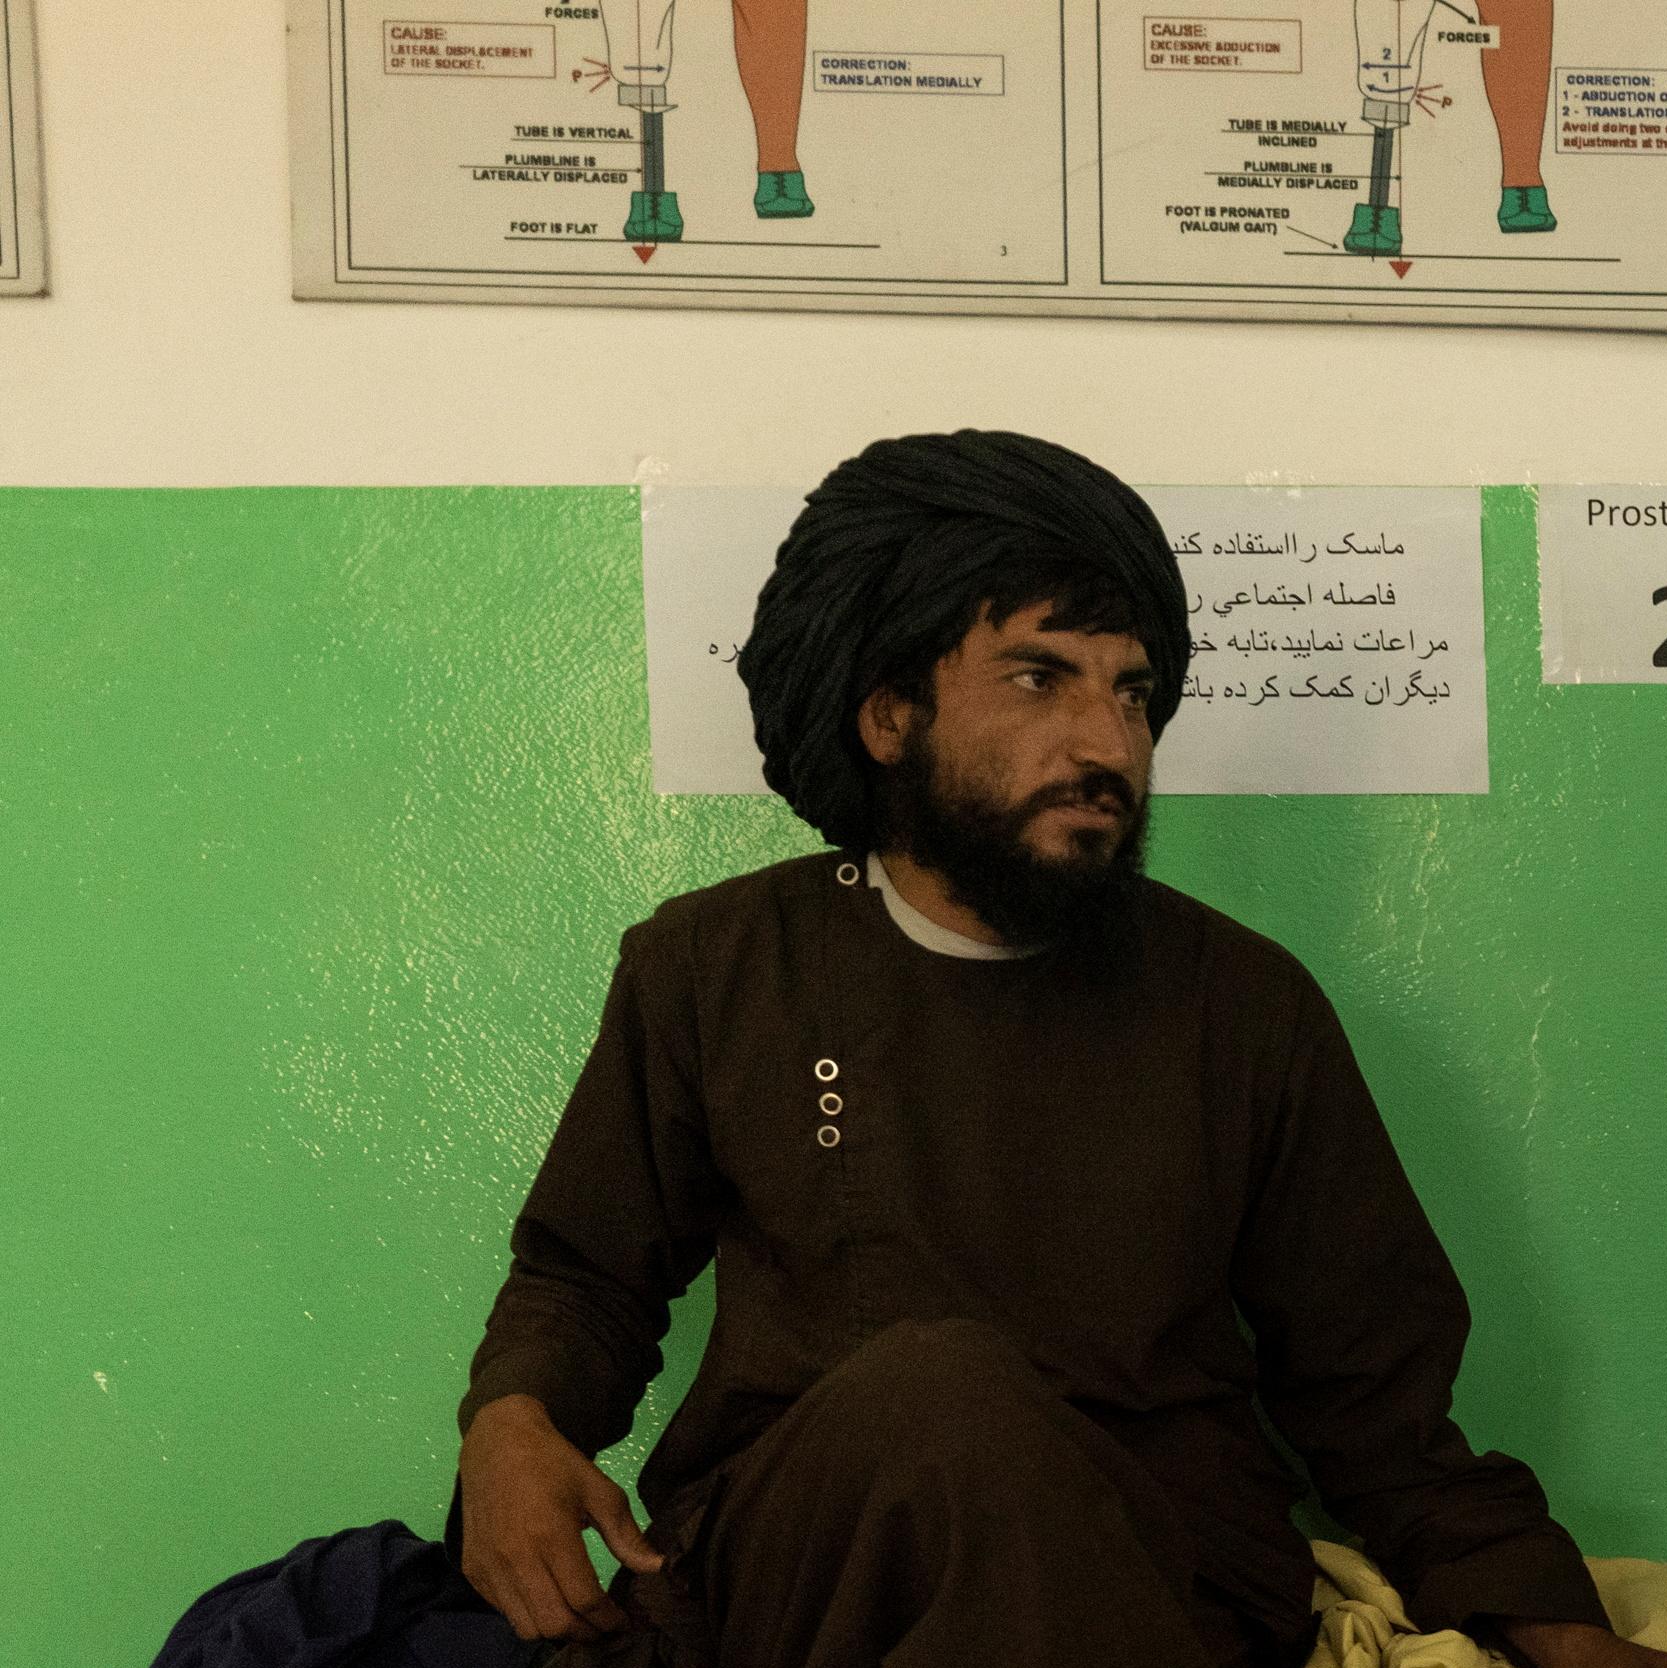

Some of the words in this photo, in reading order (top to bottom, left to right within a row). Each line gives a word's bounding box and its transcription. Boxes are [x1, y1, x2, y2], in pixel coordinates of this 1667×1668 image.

[545, 7, 599, 19] FORCES
[391, 27, 447, 40] CAUSE:
[1151, 23, 1207, 37] CAUSE:
[1438, 31, 1490, 43] FORCES
[391, 44, 440, 56] LATERAL
[446, 46, 533, 58] DISPLACEMENT
[1151, 40, 1212, 52] EXCESSIVE
[1151, 54, 1164, 64] OF
[1170, 54, 1190, 65] THE
[1194, 55, 1242, 66] SOCKET.
[1382, 48, 1391, 60] 2
[391, 58, 405, 68] OF
[411, 58, 432, 69] THE
[435, 59, 485, 70] SOCKET.
[821, 58, 911, 71] CORRECTION:
[572, 70, 582, 82] P
[821, 74, 912, 86] TRANSLATION
[916, 76, 982, 88] MEDIALLY
[1383, 71, 1389, 83] 1
[1567, 75, 1655, 87] CORRECTION:
[1563, 91, 1569, 100] 1
[1582, 91, 1655, 102] ABDUCTION
[1562, 106, 1570, 116] 2
[514, 125, 549, 137] TUBE
[553, 126, 565, 137] IS
[568, 127, 634, 139] VERTICAL
[1229, 119, 1262, 131] TUBE
[1266, 119, 1277, 131] IS
[1282, 120, 1347, 132] MEDIALLY
[1563, 121, 1599, 132] Avoid
[1603, 122, 1637, 135] doing
[1640, 123, 1661, 133] two
[1258, 136, 1317, 147] INCLINED
[1563, 137, 1637, 150] adjustments
[1642, 138, 1653, 148] at
[505, 154, 580, 167] PLUMBLINE
[584, 156, 596, 167] IS
[1244, 161, 1317, 173] PLUMBLINE
[1322, 163, 1333, 173] IS
[473, 170, 549, 182] LATERALLY
[554, 171, 628, 184] DISPLACED
[1218, 177, 1281, 188] MEDIALLY
[1286, 178, 1359, 190] DISPLACED
[1166, 205, 1200, 216] FOOT
[1205, 206, 1216, 217] IS
[1220, 207, 1290, 219] PRONATED
[510, 221, 547, 233] FOOT
[551, 222, 562, 233] IS
[566, 223, 598, 234] FLAT
[1180, 221, 1240, 233] (VALGUM
[1244, 222, 1277, 235] GAIT)
[1000, 245, 1008, 257] 3
[1326, 532, 1405, 555] ماسک
[1323, 581, 1396, 606] فاصله
[1187, 593, 1202, 613] ر
[1189, 632, 1218, 659] خو
[1353, 629, 1449, 660] مراعات
[1181, 675, 1214, 705] باش
[1223, 675, 1280, 706] کرده
[1289, 675, 1354, 698] کمک
